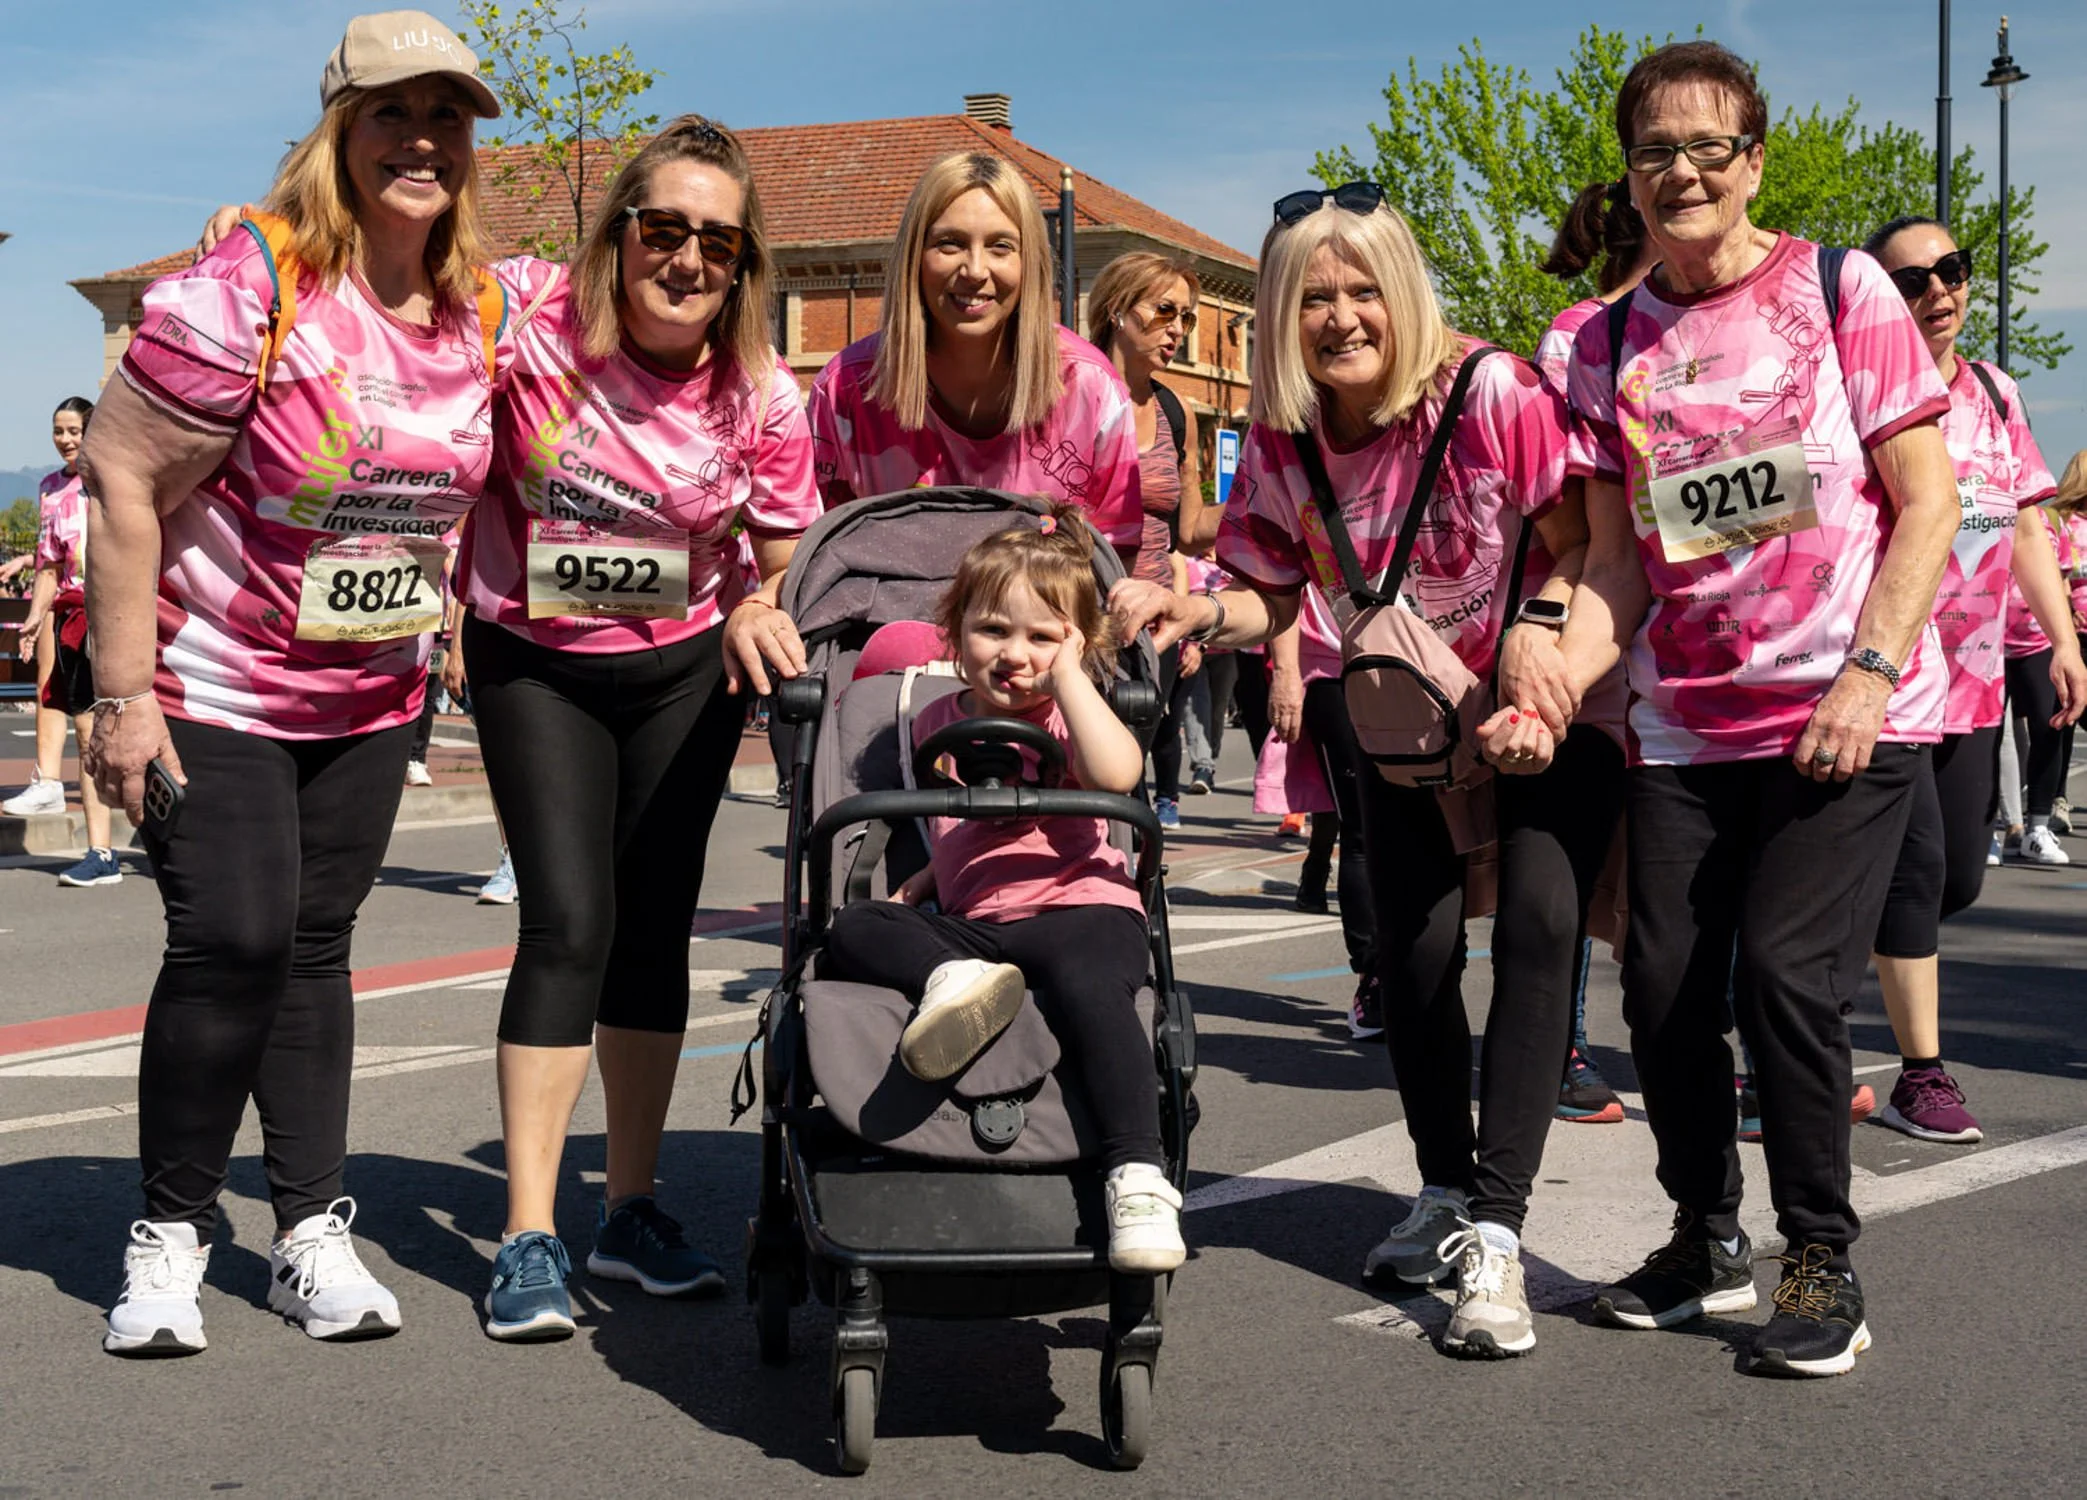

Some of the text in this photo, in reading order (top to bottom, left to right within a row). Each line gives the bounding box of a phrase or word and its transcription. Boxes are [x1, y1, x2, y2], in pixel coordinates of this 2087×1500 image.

[357, 424, 384, 452] XI
[570, 421, 600, 450] XI
[1651, 409, 1674, 436] XI
[287, 408, 353, 526] mujer
[350, 458, 451, 488] Carrera
[523, 403, 570, 513] mujer
[558, 449, 657, 511] Carrera
[1680, 460, 1785, 527] 9212
[333, 493, 414, 512] por la
[549, 479, 620, 518] por la
[328, 564, 423, 613] 8822
[555, 553, 661, 595] 9522
[1707, 591, 1731, 602] Rioja
[1774, 650, 1813, 668] Ferrer
